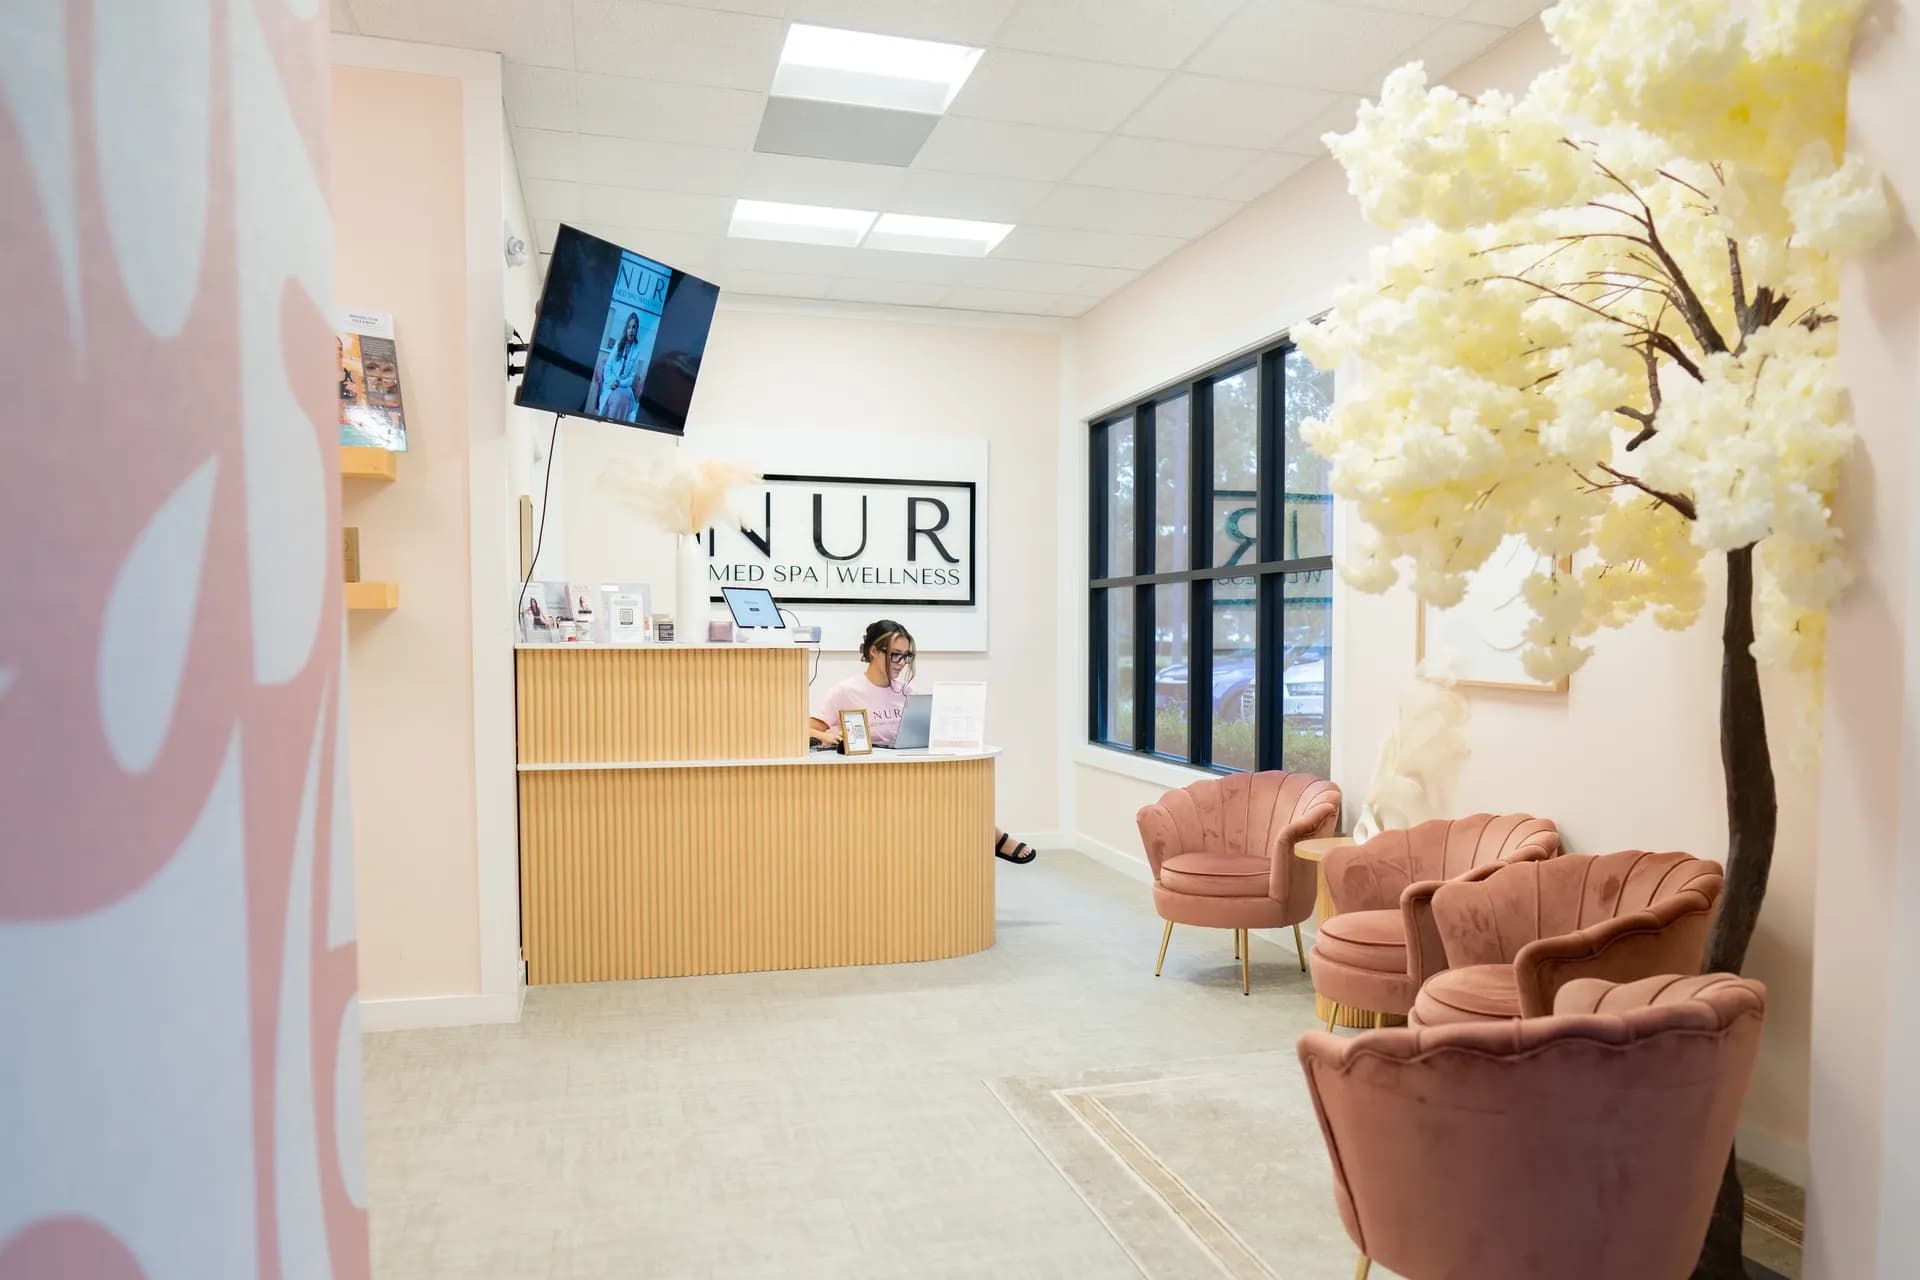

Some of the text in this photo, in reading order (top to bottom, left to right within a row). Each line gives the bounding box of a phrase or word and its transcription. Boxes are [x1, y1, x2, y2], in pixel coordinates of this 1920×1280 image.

[617, 263, 665, 303] NUR
[709, 564, 960, 586] MED SPA WELLNESS
[873, 708, 902, 720] NUR
